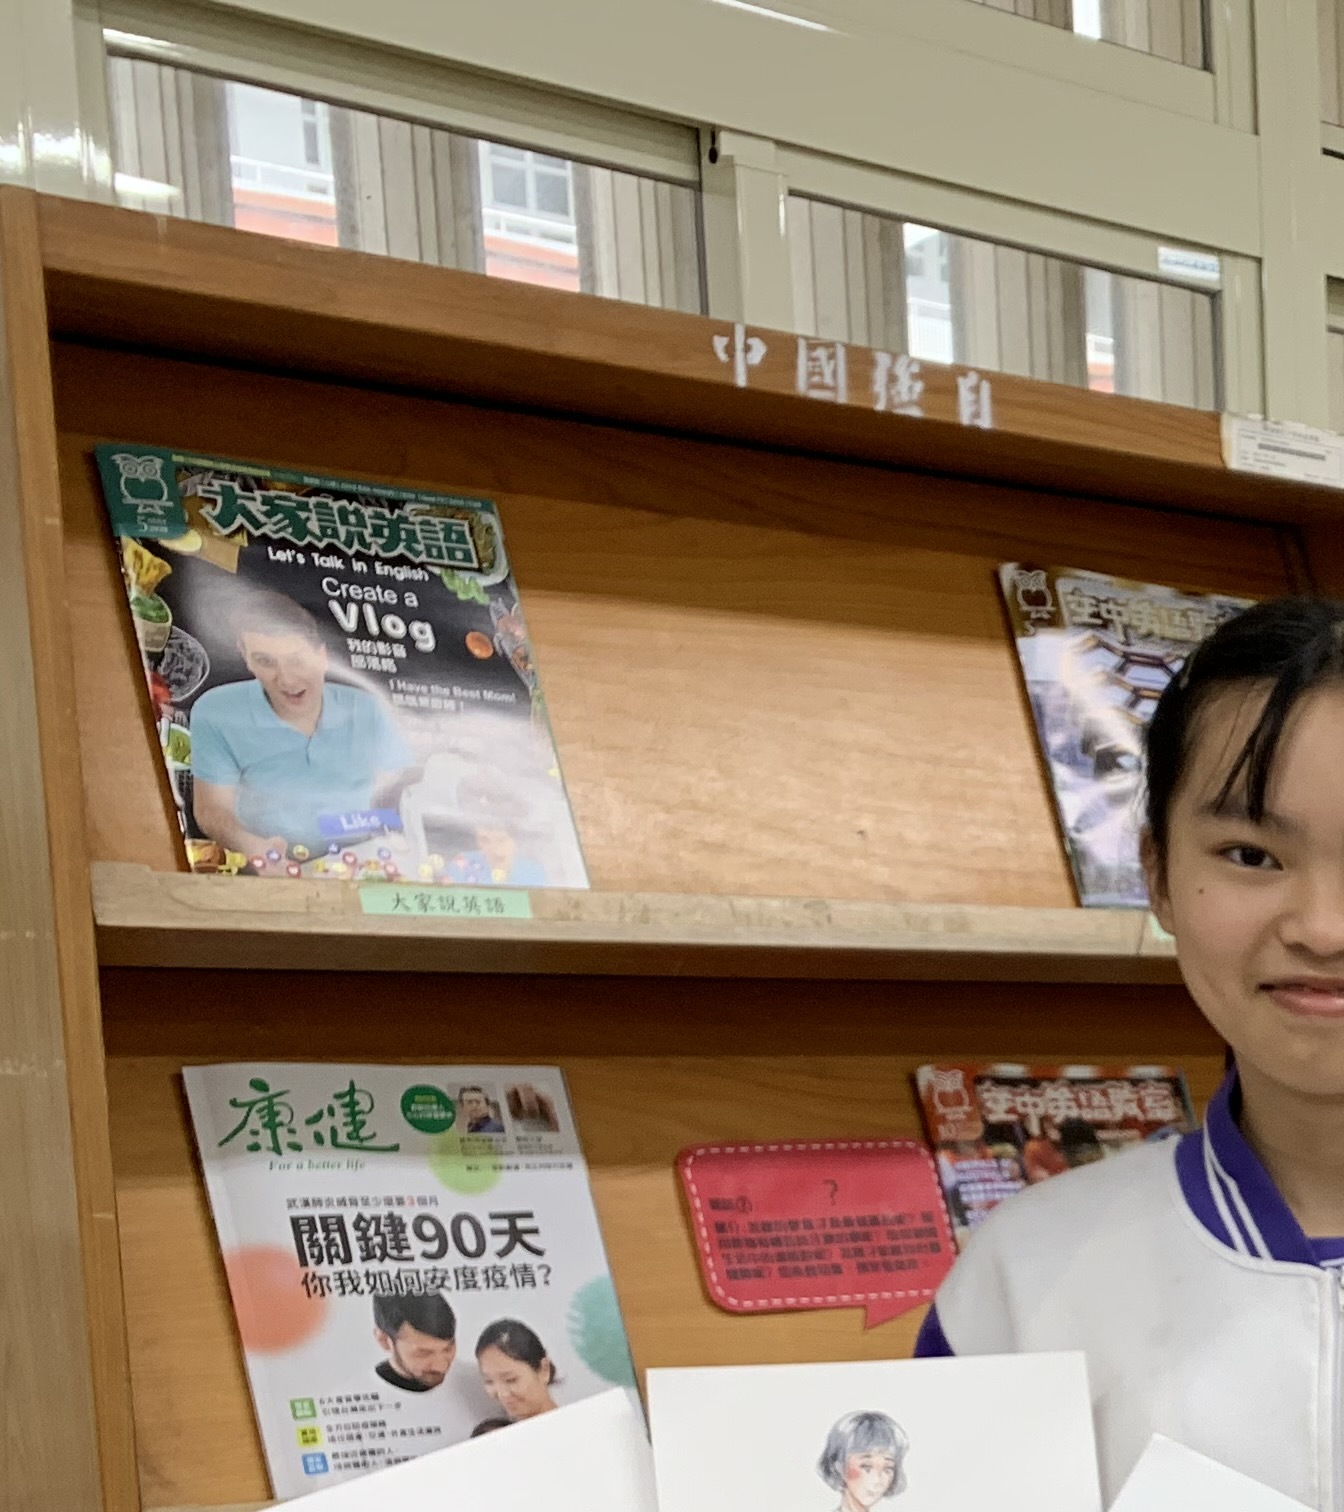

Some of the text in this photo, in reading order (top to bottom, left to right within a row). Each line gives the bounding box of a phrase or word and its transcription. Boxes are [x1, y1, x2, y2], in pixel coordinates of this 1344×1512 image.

[198, 479, 479, 568] 大家說英語
[267, 546, 305, 565] Let's
[311, 551, 345, 569] Talk
[375, 561, 429, 581] English
[321, 576, 418, 608] Create a
[328, 598, 436, 652] Vlog
[338, 812, 381, 831] Like
[391, 892, 506, 915] 大家說英語
[219, 1078, 400, 1157] 康健
[308, 1159, 343, 1172] better
[347, 1158, 366, 1172] life
[290, 1210, 545, 1267] 關鍵90天
[301, 1263, 552, 1299] 你我如何安度疫情?
